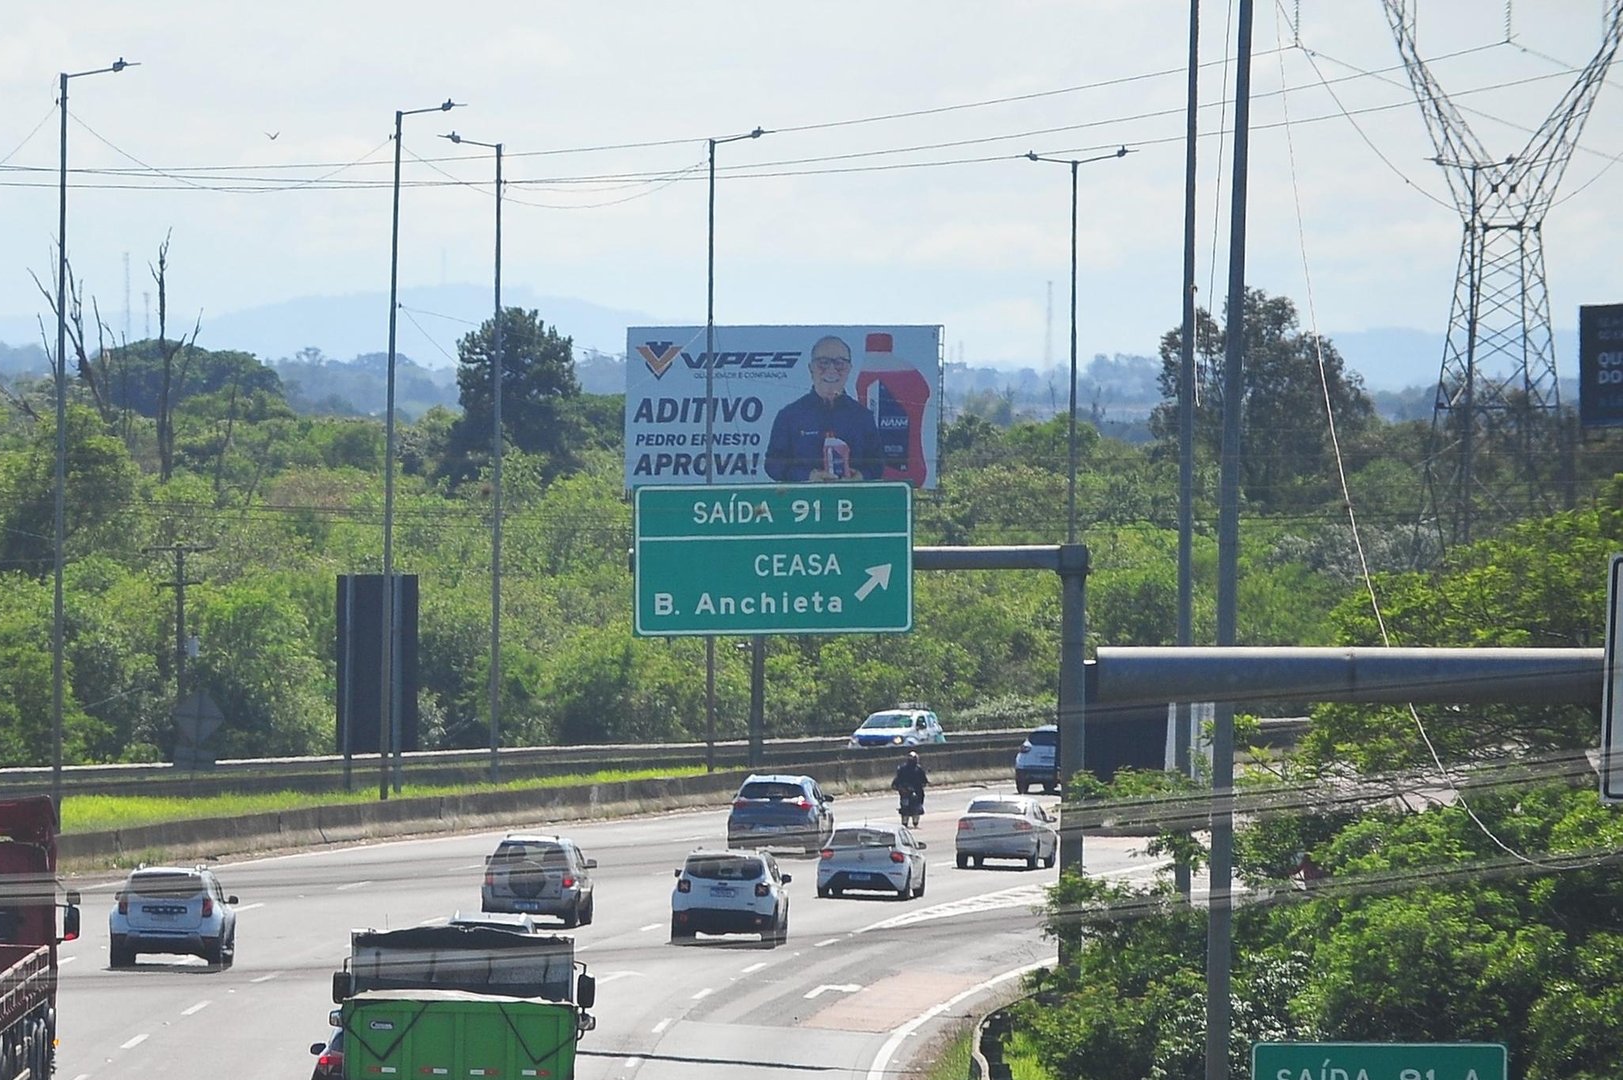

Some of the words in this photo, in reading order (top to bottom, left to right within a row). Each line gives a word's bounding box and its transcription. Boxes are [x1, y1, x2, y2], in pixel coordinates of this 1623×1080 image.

[680, 351, 802, 369] VIPES
[633, 396, 764, 423] ADITIVO
[635, 433, 687, 446] PEDRO
[633, 452, 760, 476] APROVA!
[693, 493, 774, 524] SAÍDA
[791, 500, 821, 522] 91
[837, 499, 854, 521] B
[754, 553, 842, 576] CEASA
[654, 593, 680, 616] B.
[695, 591, 843, 615] Anchieta
